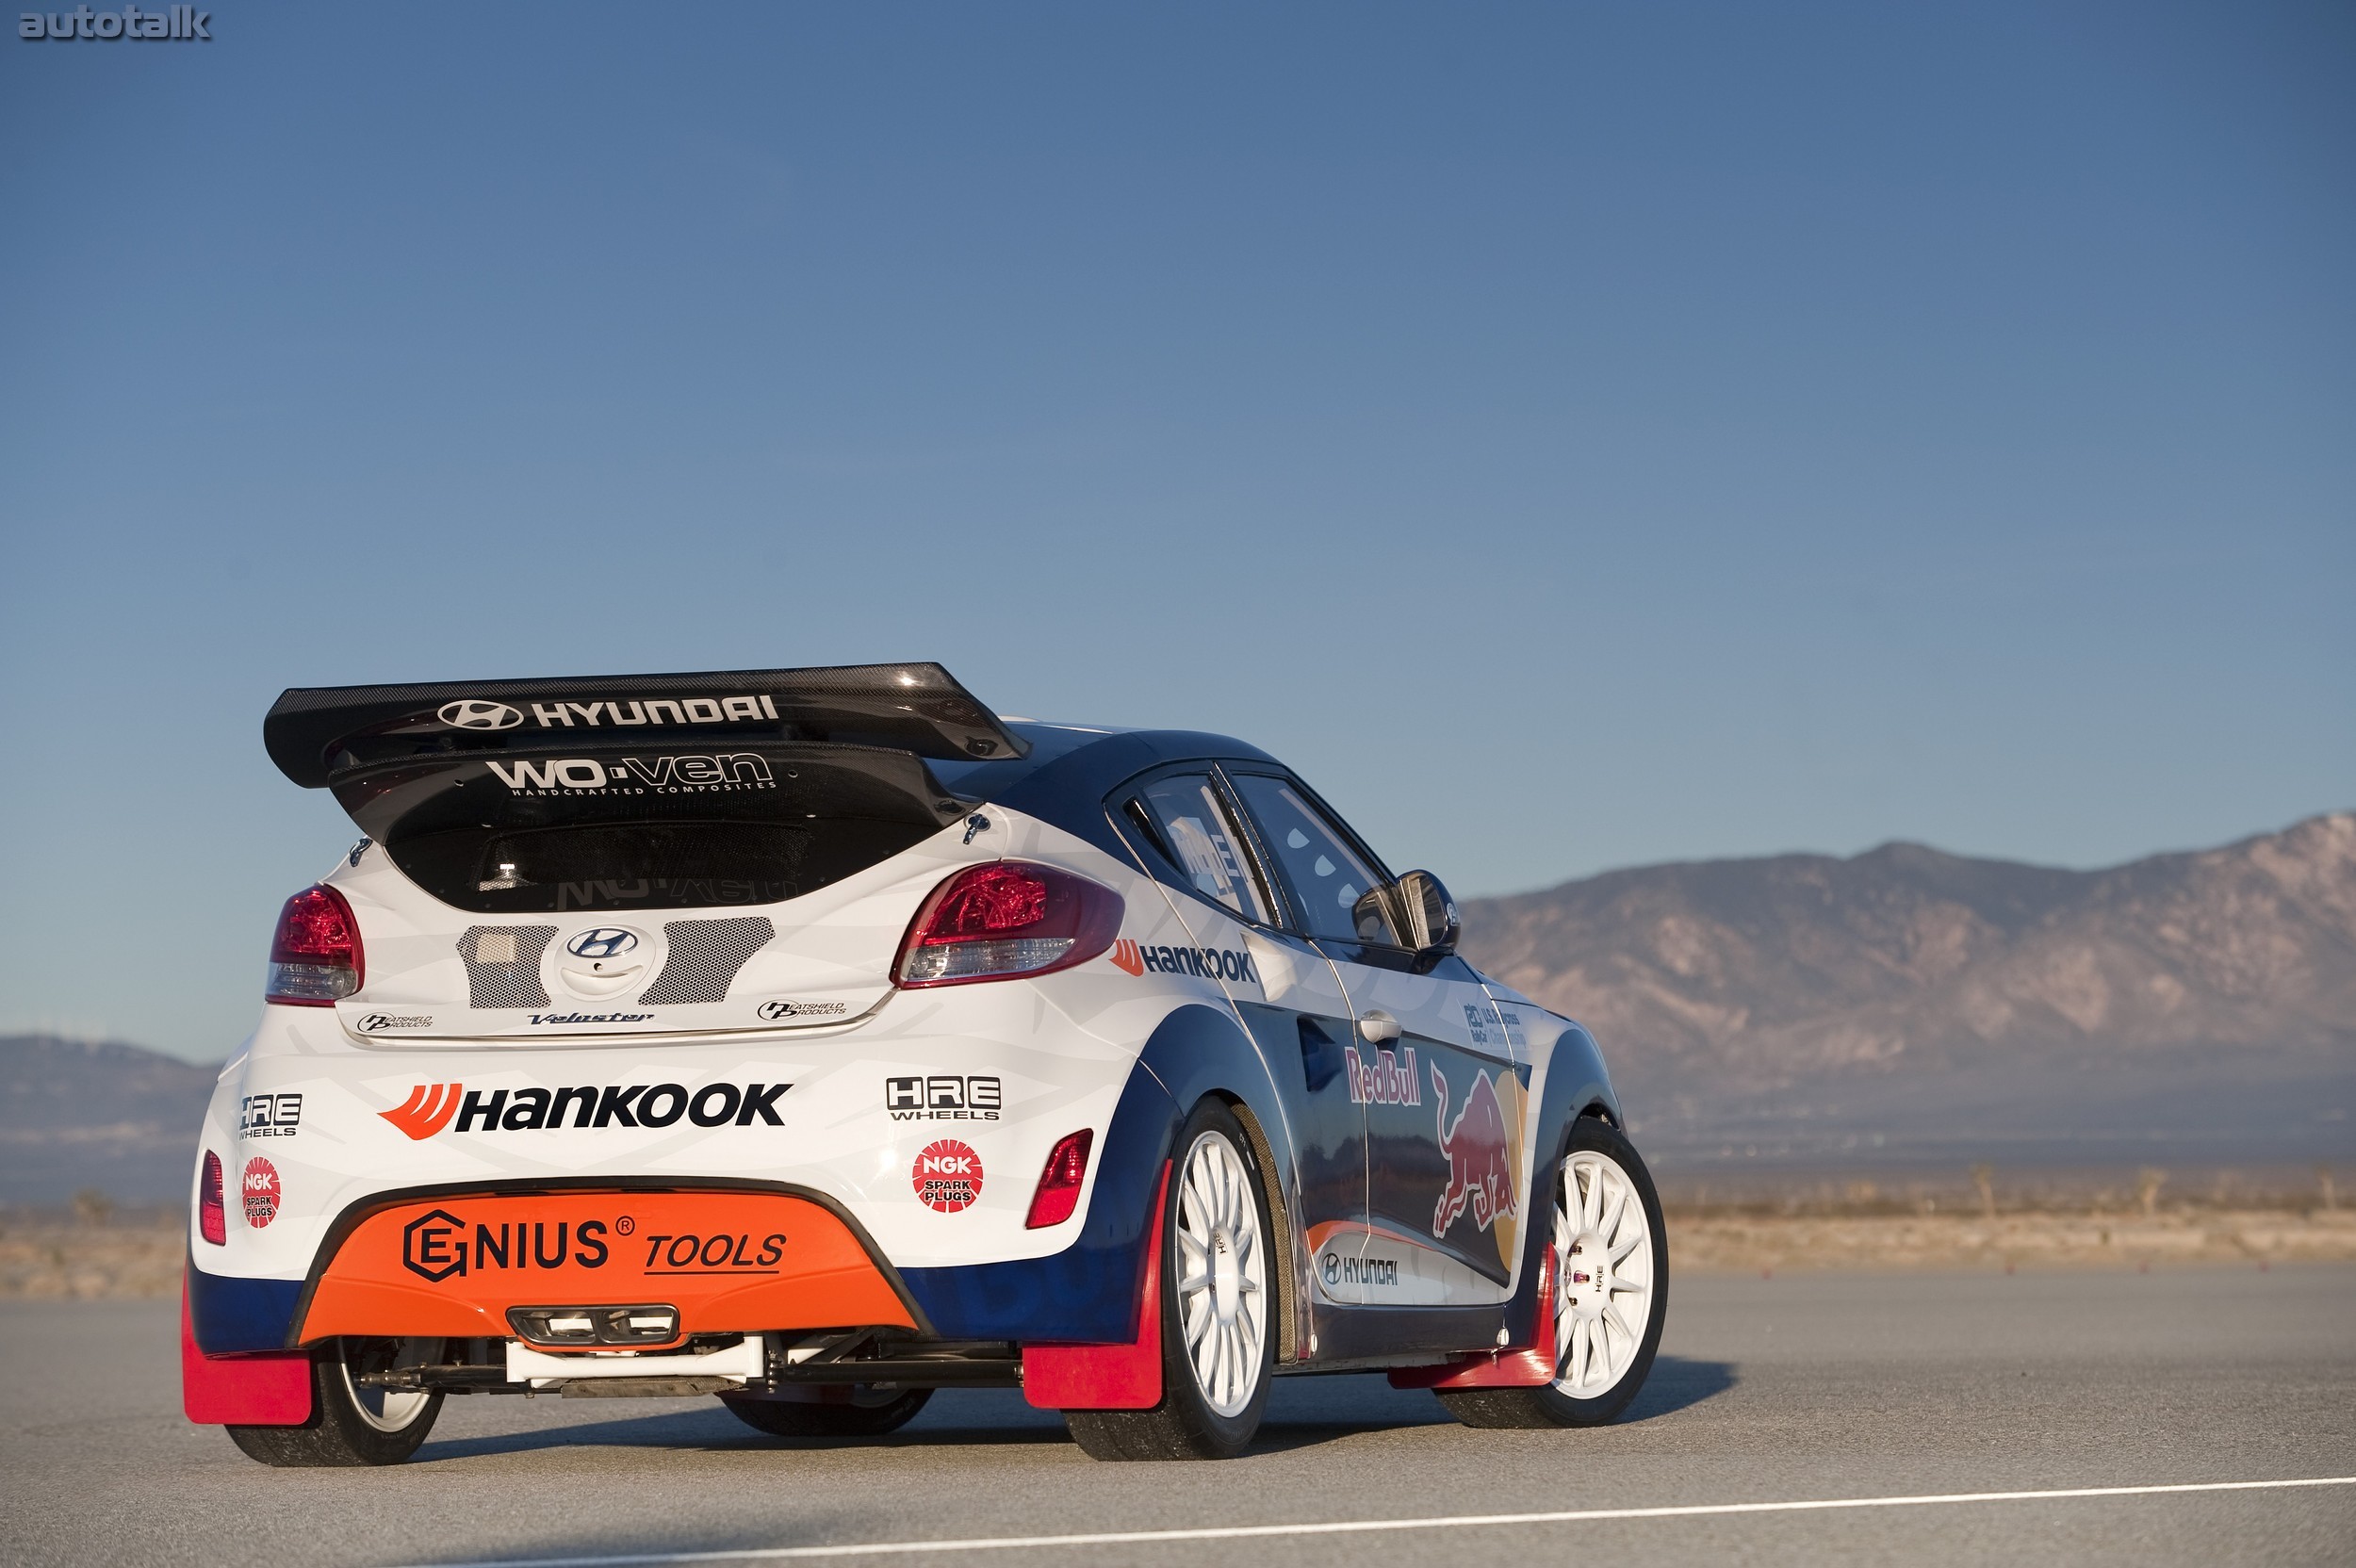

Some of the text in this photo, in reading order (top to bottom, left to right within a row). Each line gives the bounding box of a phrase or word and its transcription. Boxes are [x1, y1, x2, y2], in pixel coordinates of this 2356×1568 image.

[532, 694, 780, 727] HYUNDAI
[512, 781, 777, 797] HANDCRAFTED COMPOSITES
[1344, 1046, 1421, 1106] Red Bull
[886, 1075, 1002, 1111] HRE
[239, 1093, 303, 1131] HRE
[890, 1110, 1000, 1121] WHEELS
[924, 1155, 973, 1175] NGK
[245, 1172, 273, 1191] NGK
[924, 1180, 972, 1190] SPARK
[246, 1196, 272, 1207] SPARK
[924, 1191, 972, 1201] PLUGS
[246, 1207, 273, 1217] PLUGS
[645, 1233, 788, 1267] TOOLS
[1343, 1256, 1399, 1286] HYUNDAI
[1595, 1266, 1604, 1293] HRE
